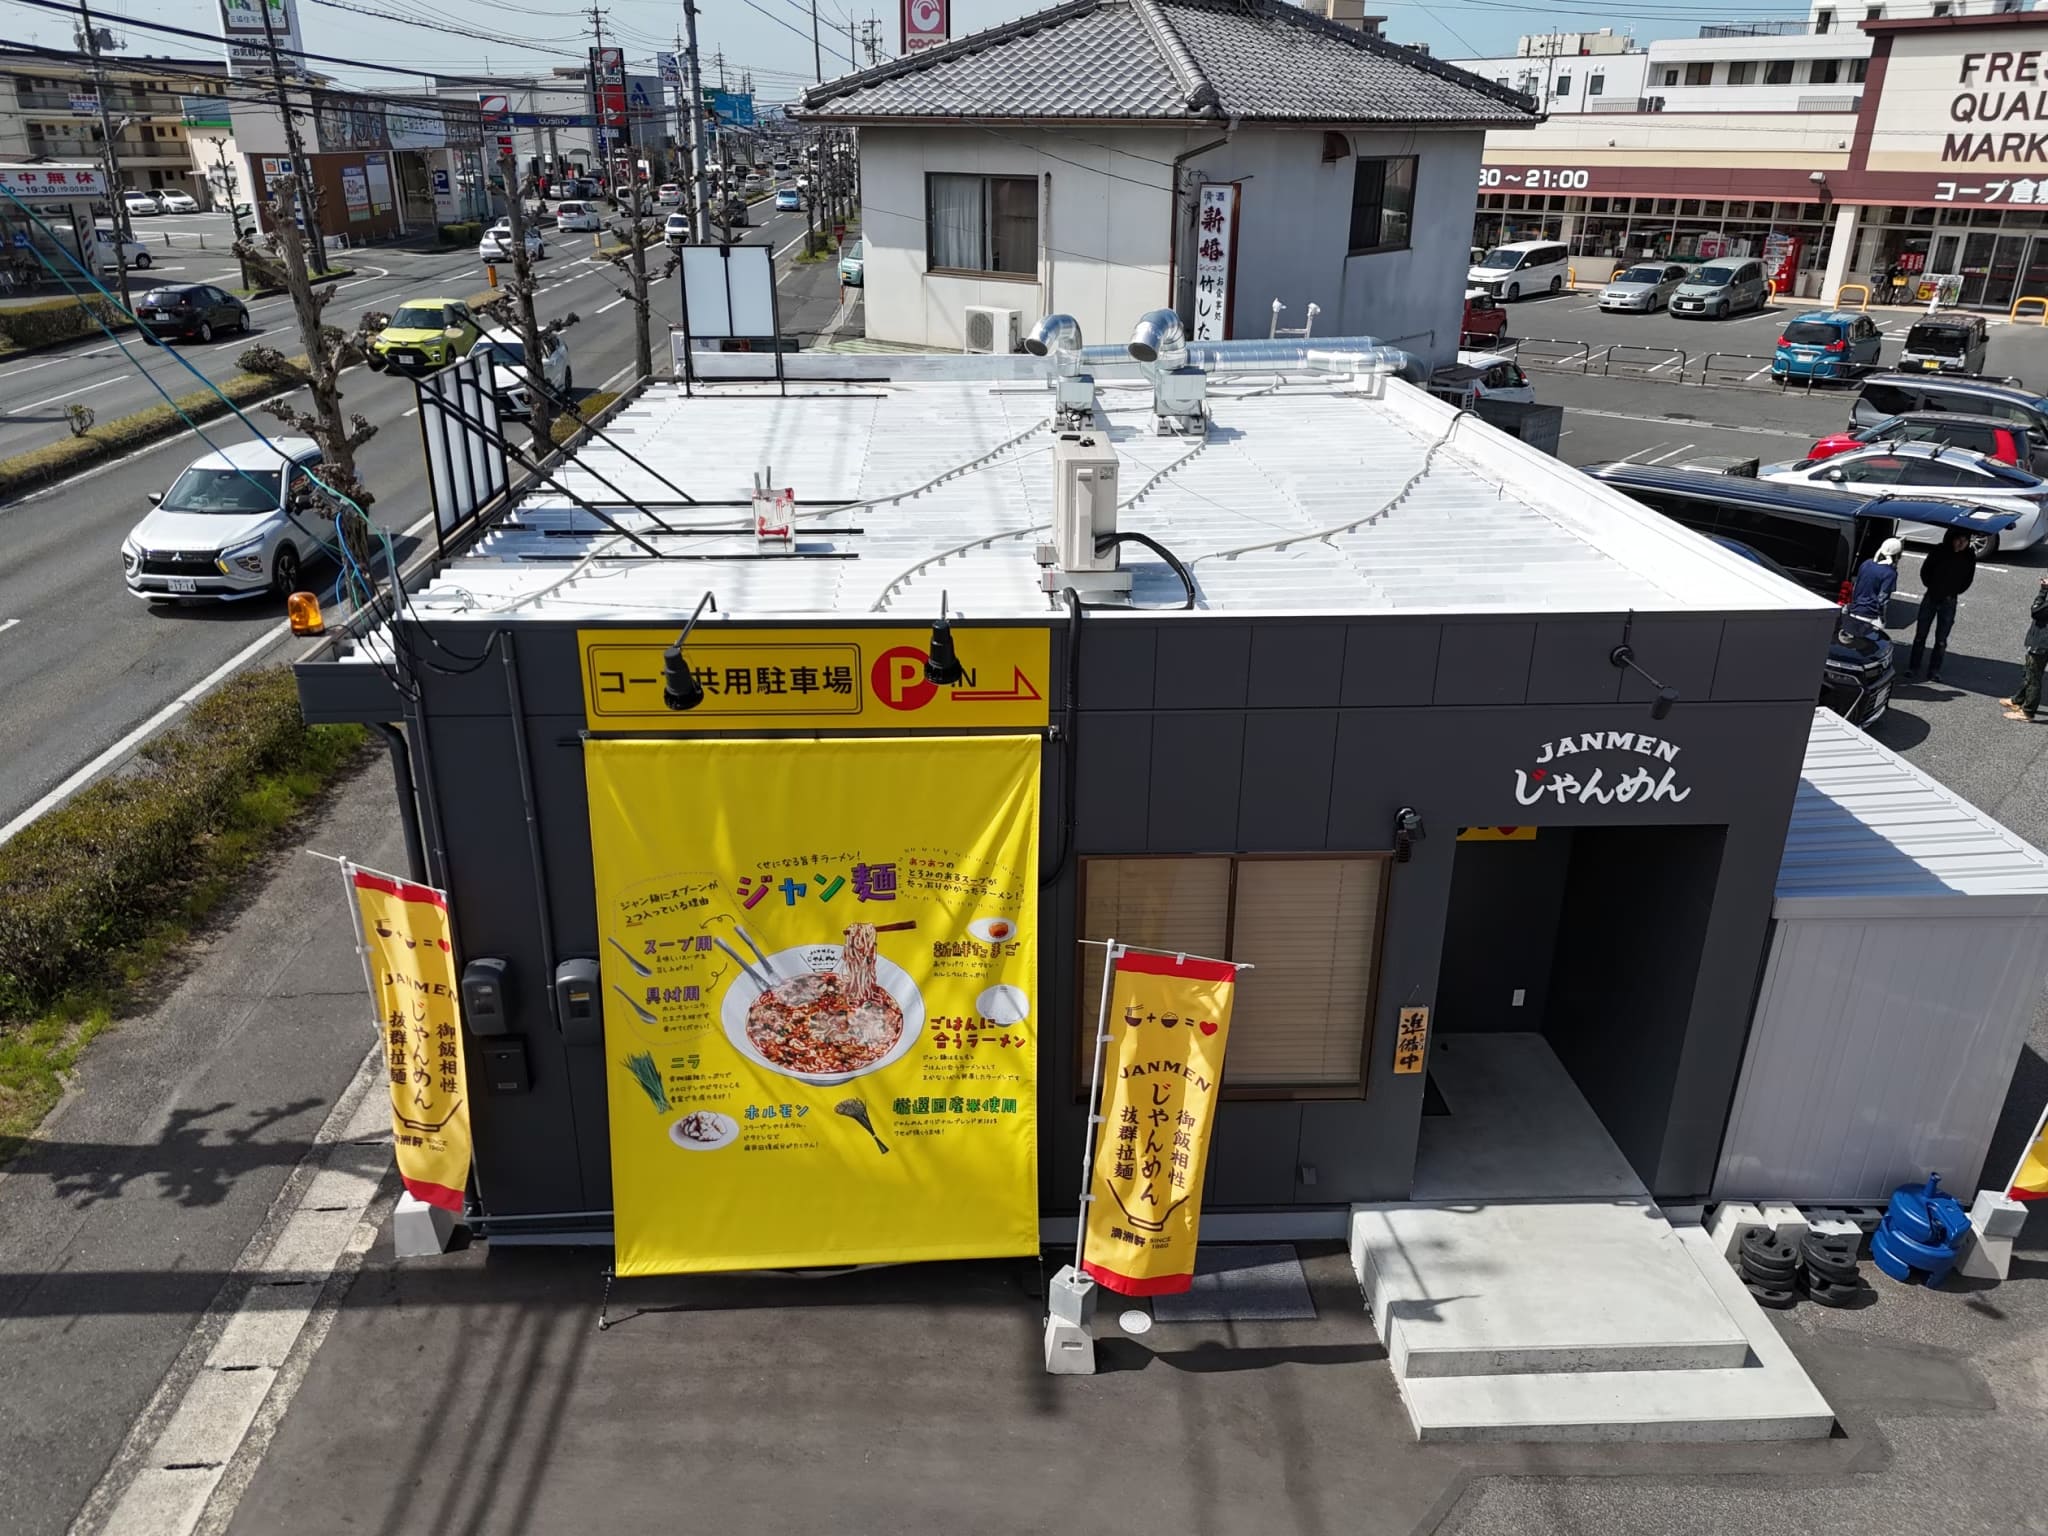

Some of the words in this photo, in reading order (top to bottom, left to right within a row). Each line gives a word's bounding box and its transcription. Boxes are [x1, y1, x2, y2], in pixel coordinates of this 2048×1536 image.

[1959, 51, 2048, 83] FRE
[1941, 133, 2048, 163] MARK
[599, 666, 853, 696] コー共用駐車場
[889, 656, 927, 703] P
[951, 668, 977, 688] N
[1536, 731, 1681, 764] JANMEN
[1514, 766, 1692, 806] じゃんめん
[737, 863, 897, 910] ジャン麺
[644, 935, 713, 955] スープ用
[933, 941, 1020, 959] 新鮮たまご
[645, 985, 700, 1005] 具材用
[930, 1015, 996, 1031] ごはんに
[411, 999, 434, 1110] じゃんめん
[932, 1031, 1026, 1050] 合うラーメン
[670, 1054, 701, 1069] ニラ
[1120, 1060, 1213, 1093] JANMEN
[744, 1104, 809, 1120] ホルモン
[1113, 1105, 1140, 1181] 抜群拉麺
[1140, 1083, 1171, 1207] じゃんめん
[1168, 1109, 1197, 1190] 御飯相性
